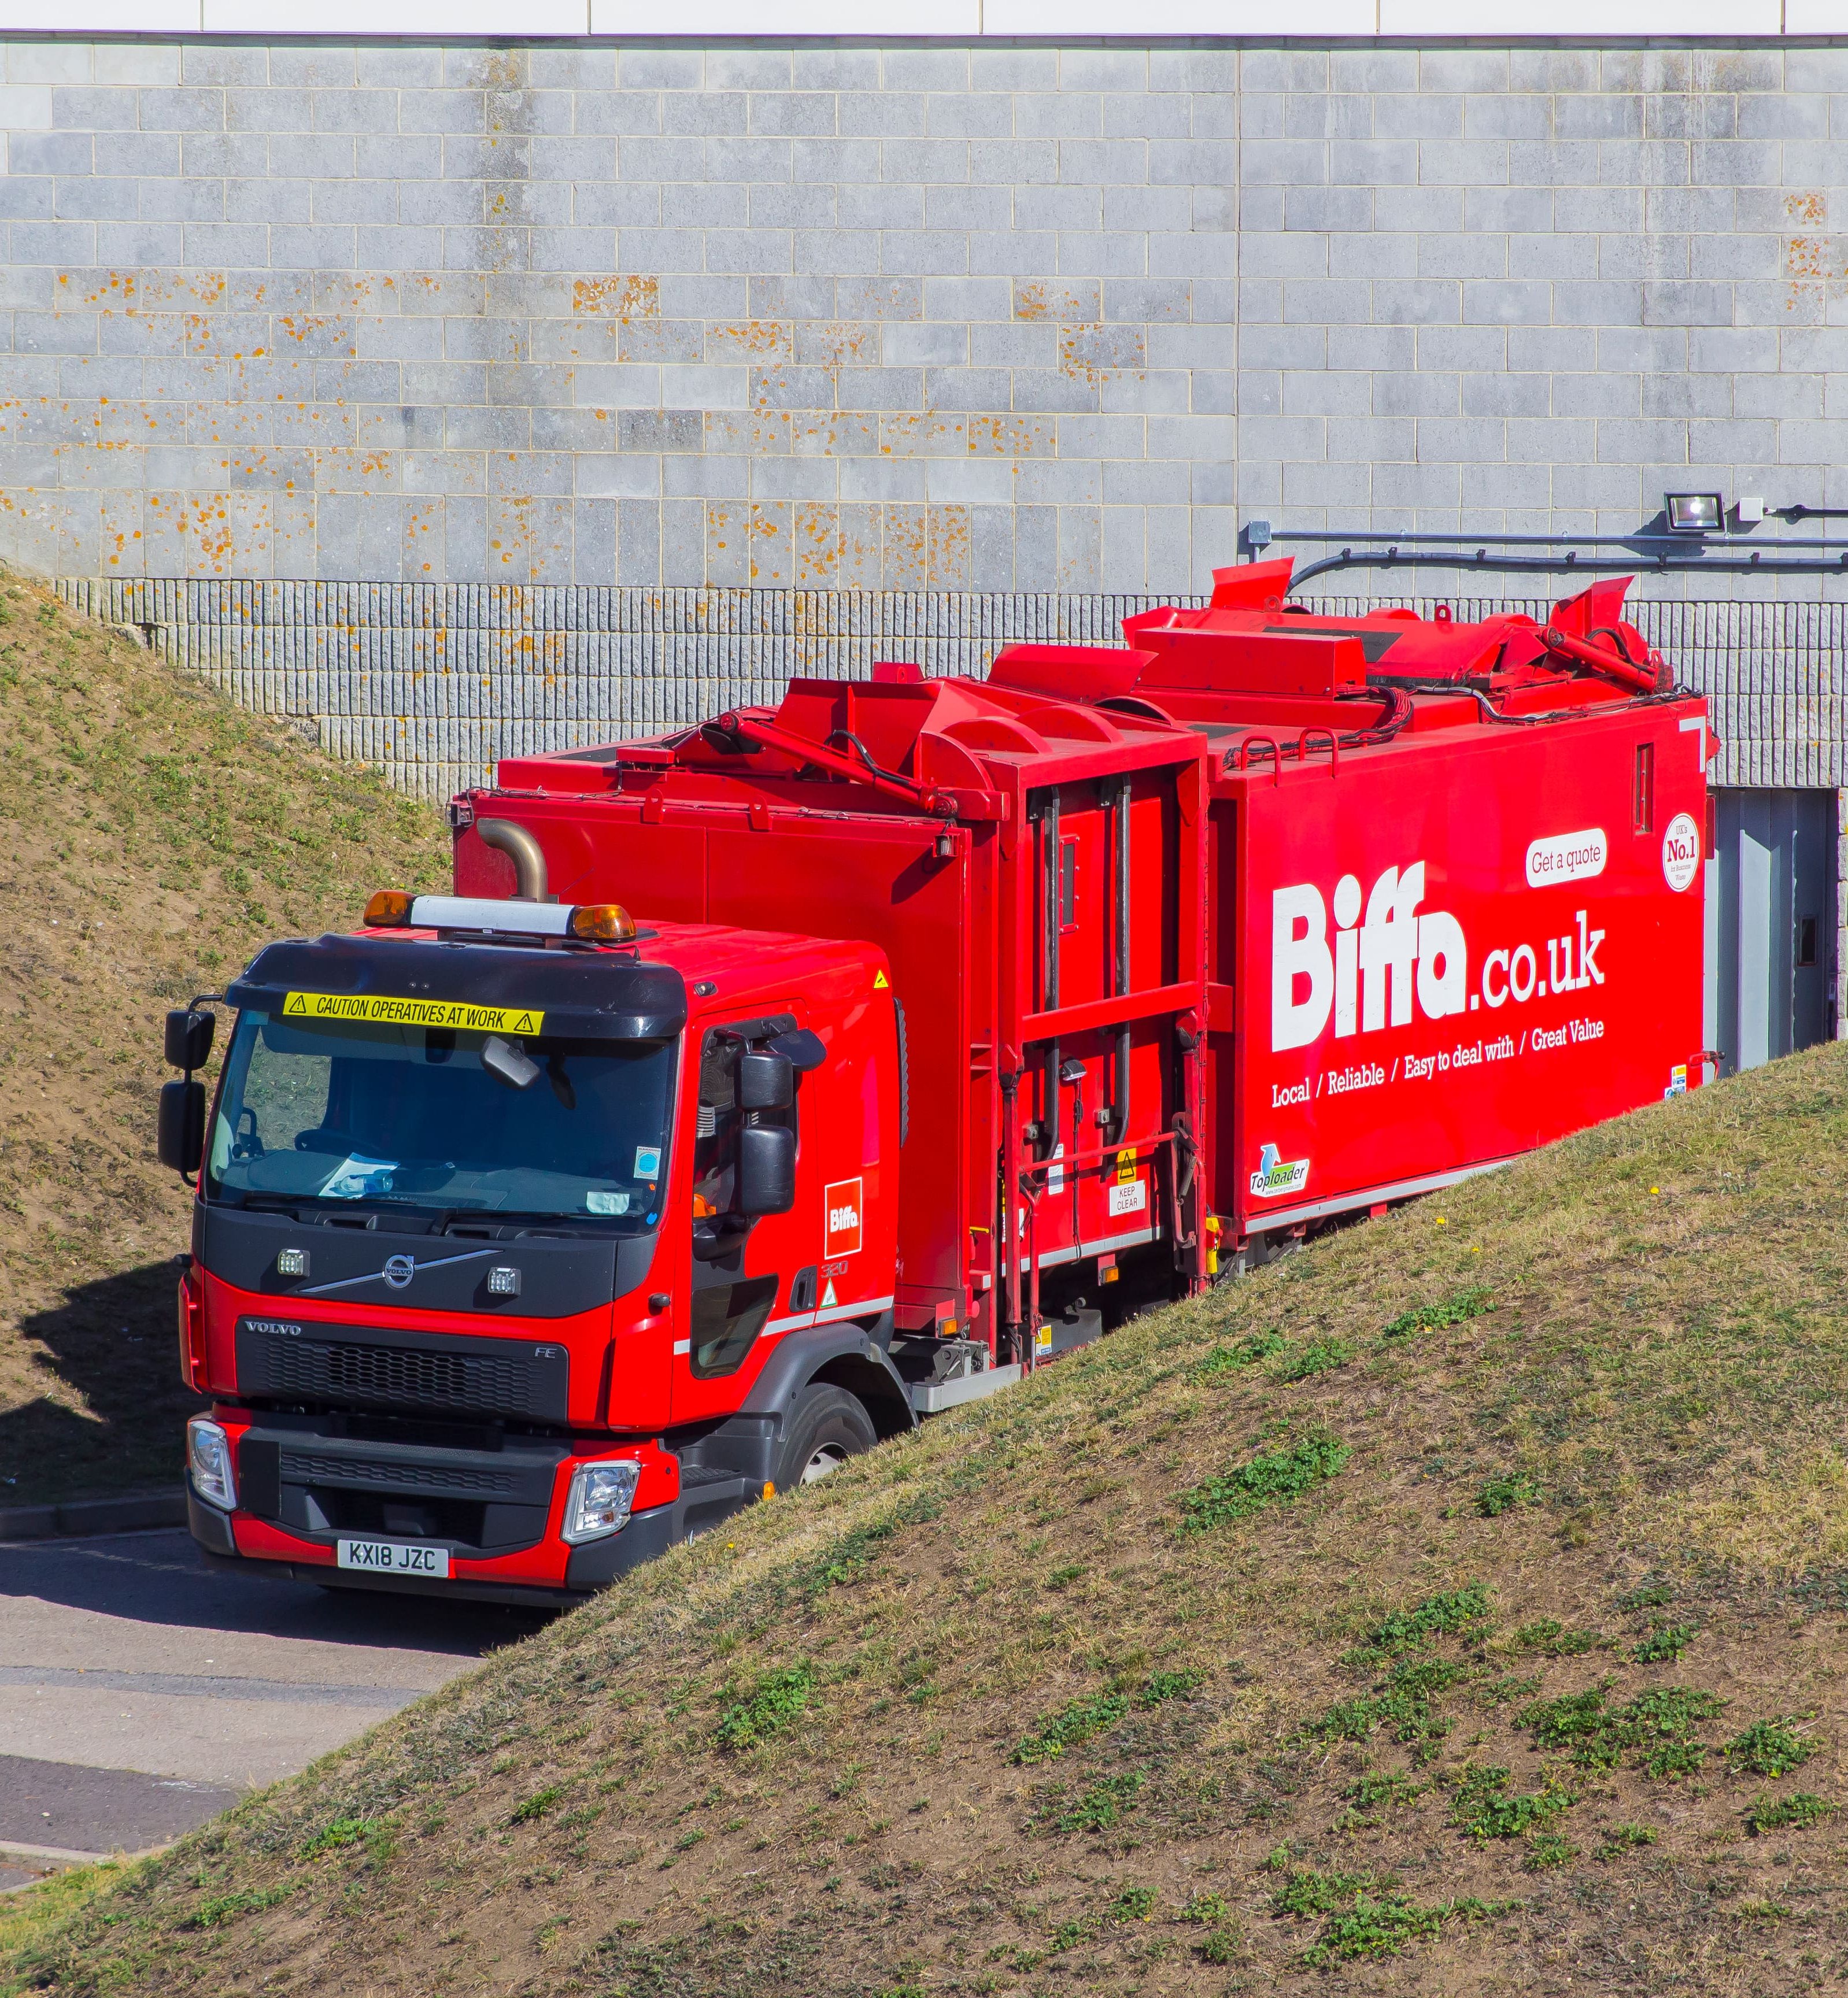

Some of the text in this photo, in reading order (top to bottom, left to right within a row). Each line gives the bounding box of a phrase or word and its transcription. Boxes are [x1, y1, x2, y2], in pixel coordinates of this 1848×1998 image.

[1676, 824, 1688, 835] UK's
[1667, 836, 1695, 862] No.1
[1532, 843, 1601, 874] Get a quote
[317, 996, 507, 1029] CAUTION OPERATIVES AT WORK
[1272, 1077, 1310, 1108] Local
[1328, 1063, 1385, 1095] Reliable
[1405, 1054, 1436, 1080] Easy
[1438, 1050, 1450, 1071] to
[1452, 1041, 1482, 1068] deal
[1485, 1035, 1514, 1061] with
[1532, 1024, 1566, 1051] Great
[1569, 1018, 1604, 1043] Value
[1119, 1186, 1136, 1198] KEEP
[1117, 1197, 1138, 1211] CLEAR
[821, 1261, 848, 1278] 320
[245, 1320, 301, 1335] VOLVO
[535, 1348, 557, 1359] FE
[350, 1542, 435, 1571] KX18 JZC
